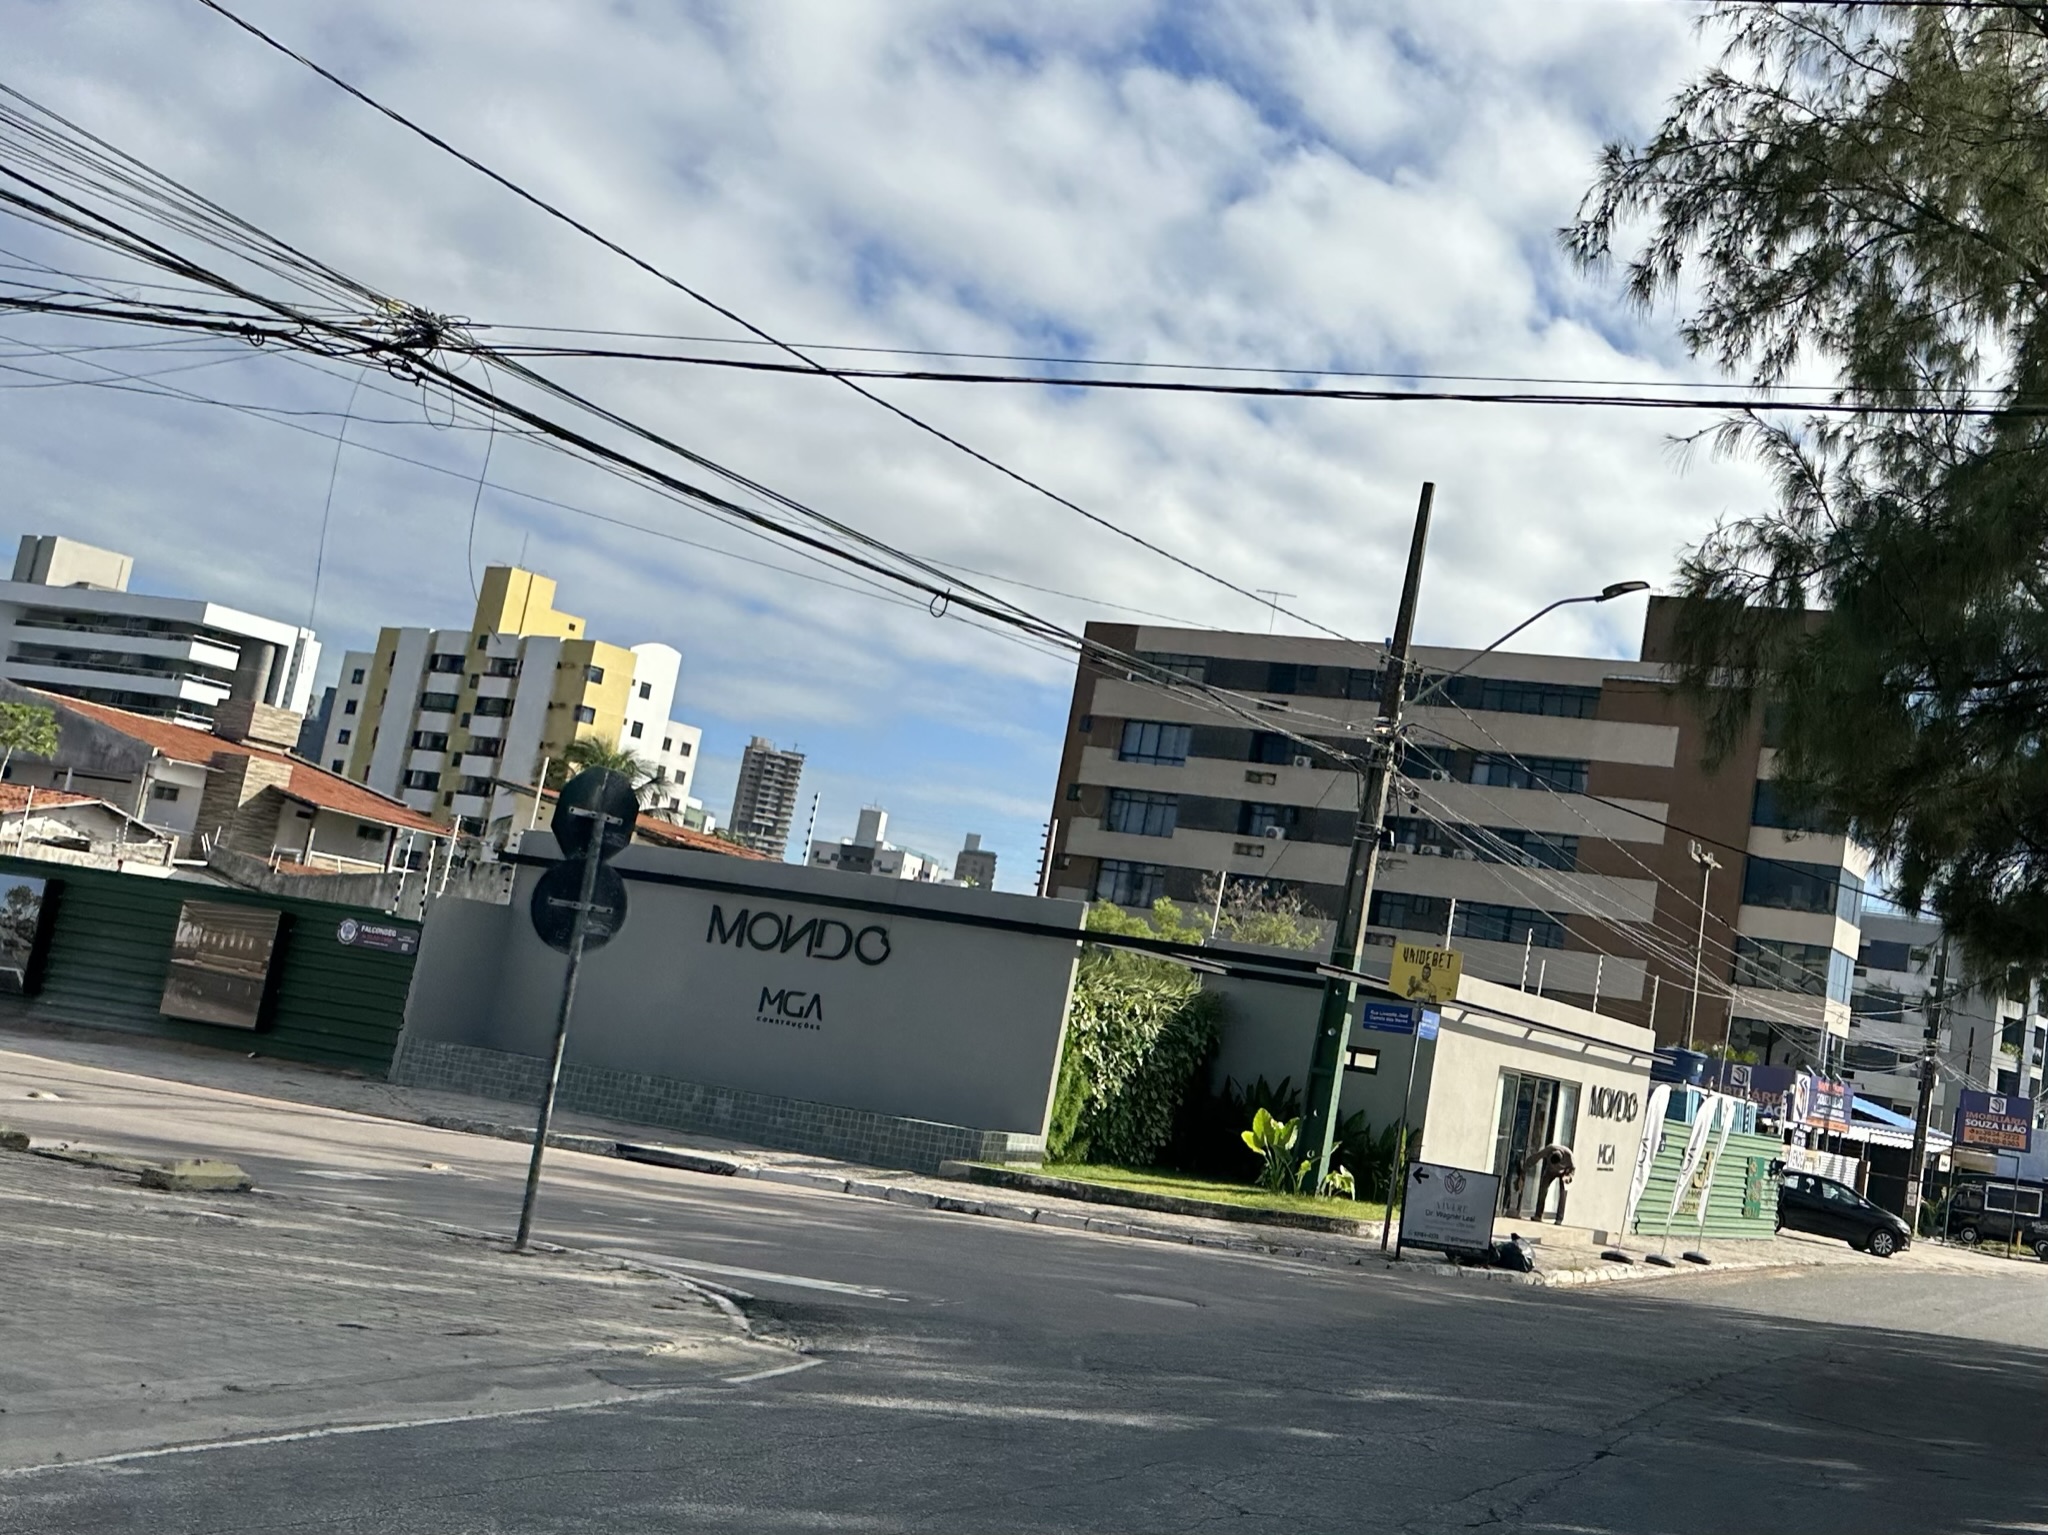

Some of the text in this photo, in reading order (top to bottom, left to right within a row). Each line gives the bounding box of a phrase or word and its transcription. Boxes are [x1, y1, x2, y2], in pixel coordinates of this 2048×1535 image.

[706, 904, 891, 966] MONDO
[757, 986, 823, 1021] MGA
[756, 1015, 821, 1031] CONSTRUÇÕES
[1588, 1084, 1638, 1123] MONDO
[1965, 1111, 2028, 1127] IMOBILIÁRIA
[1965, 1118, 2027, 1134] SOUZA LEÃO
[1436, 1210, 1462, 1220] Wagner
